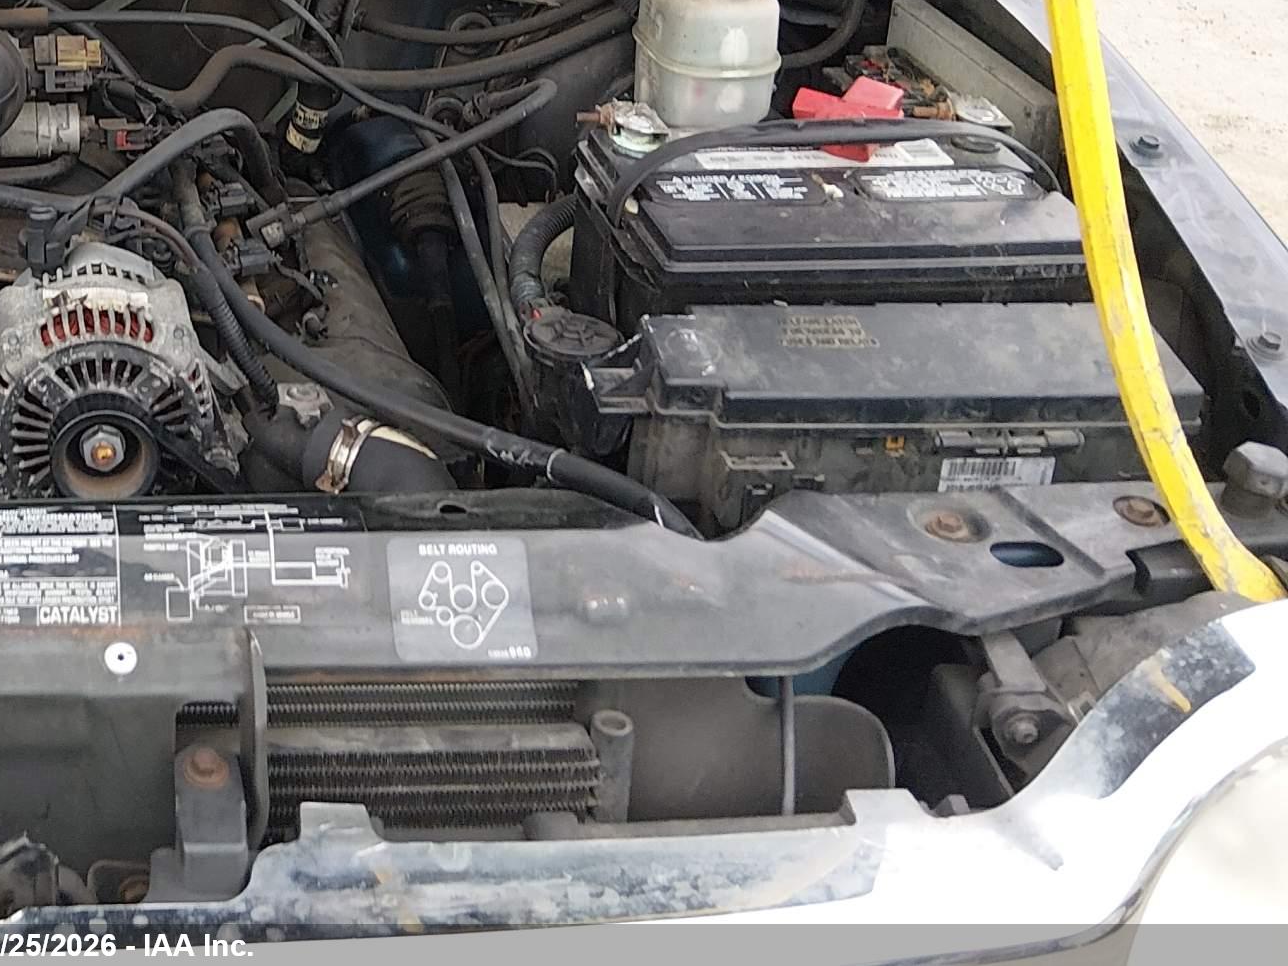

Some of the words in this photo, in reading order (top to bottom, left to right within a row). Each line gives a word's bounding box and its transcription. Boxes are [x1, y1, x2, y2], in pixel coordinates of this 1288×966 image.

[418, 544, 445, 556] BELT
[448, 543, 498, 556] ROUTING
[39, 606, 118, 625] CATALYST
